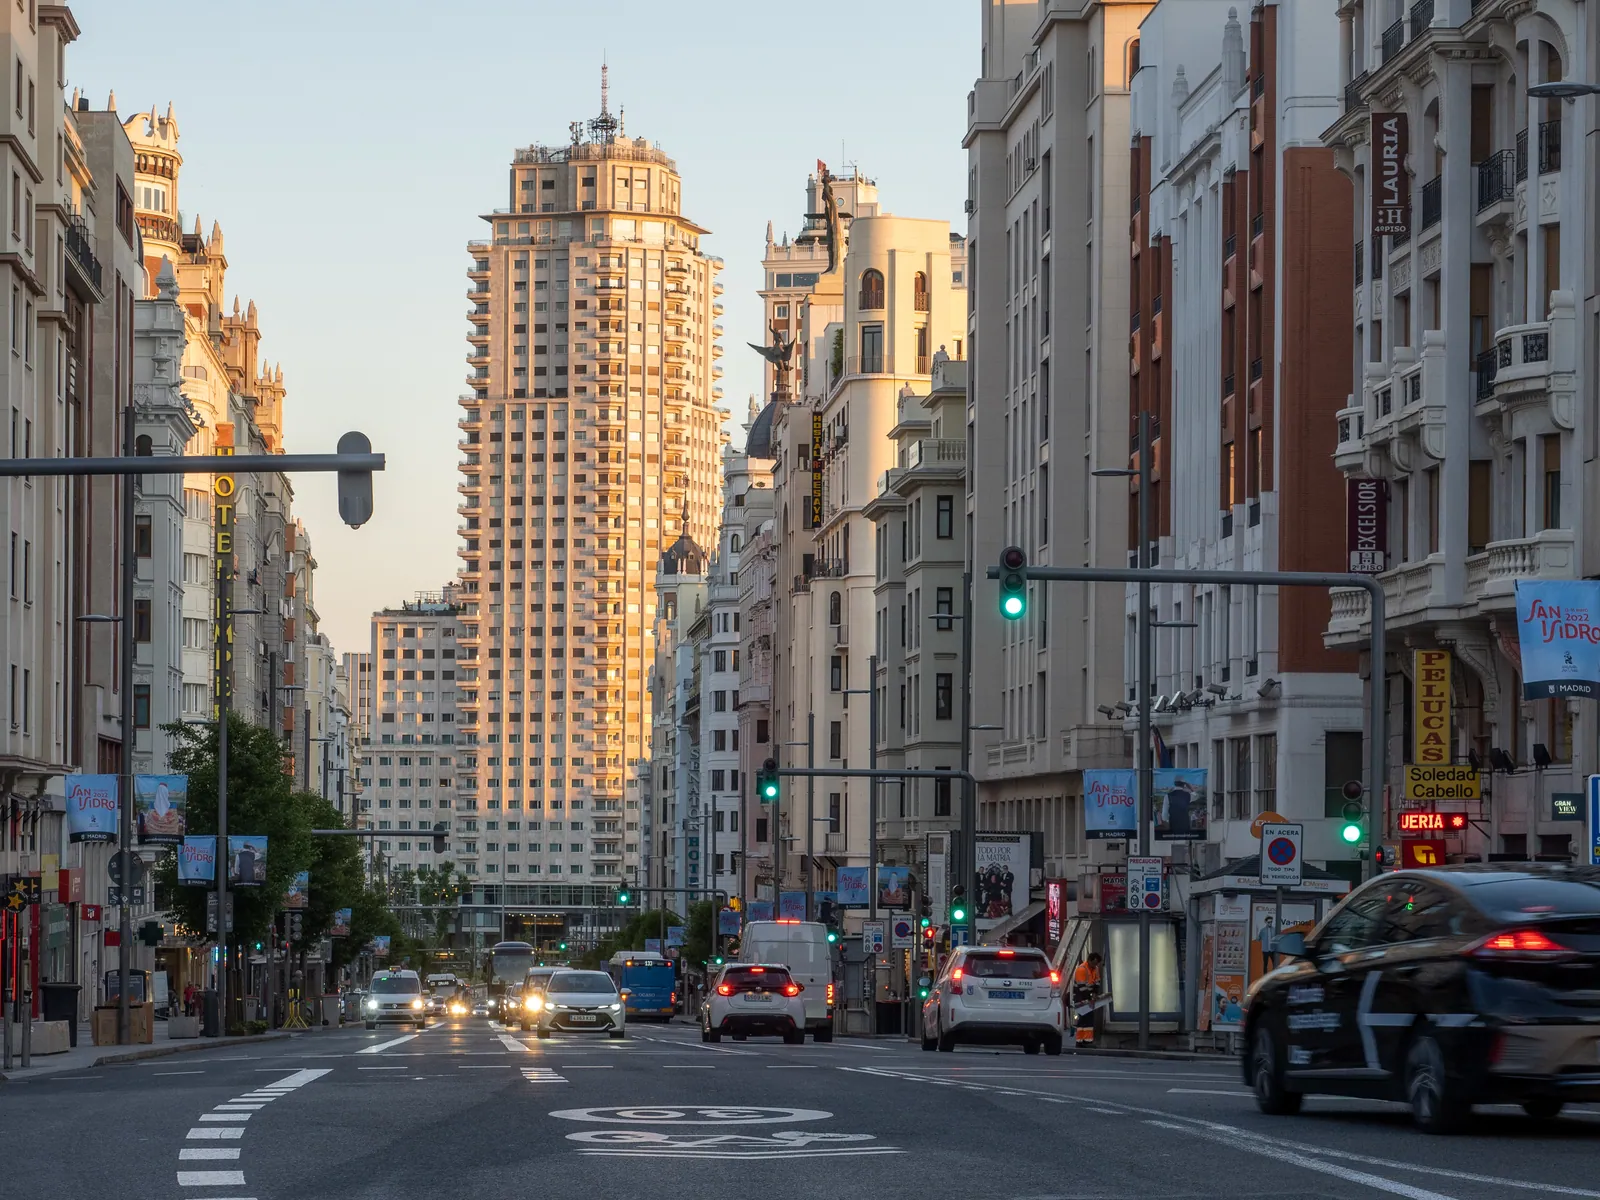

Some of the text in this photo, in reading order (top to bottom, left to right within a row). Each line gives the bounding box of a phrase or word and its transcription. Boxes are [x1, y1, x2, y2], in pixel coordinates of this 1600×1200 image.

[1383, 117, 1399, 205] LAURIA
[813, 415, 822, 457] HOSTAL
[813, 472, 822, 523] BESAYA
[1358, 482, 1377, 550] EXCELSIOR
[1524, 599, 1561, 623] SAN
[1564, 613, 1590, 622] 2022
[1542, 619, 1600, 645] ISIDRO
[1559, 685, 1591, 693] MADRID
[1420, 652, 1446, 762] PELUCAS
[1410, 767, 1476, 781] Soledad
[68, 784, 91, 799] SAN
[1088, 781, 1110, 795] SAN
[1413, 784, 1474, 798] Cabello
[79, 797, 115, 811] ISIDRO
[1097, 794, 1135, 808] ISIDRO
[180, 843, 196, 855] SAN
[978, 846, 1011, 854] TODO POR
[186, 852, 214, 864] ISIDRO
